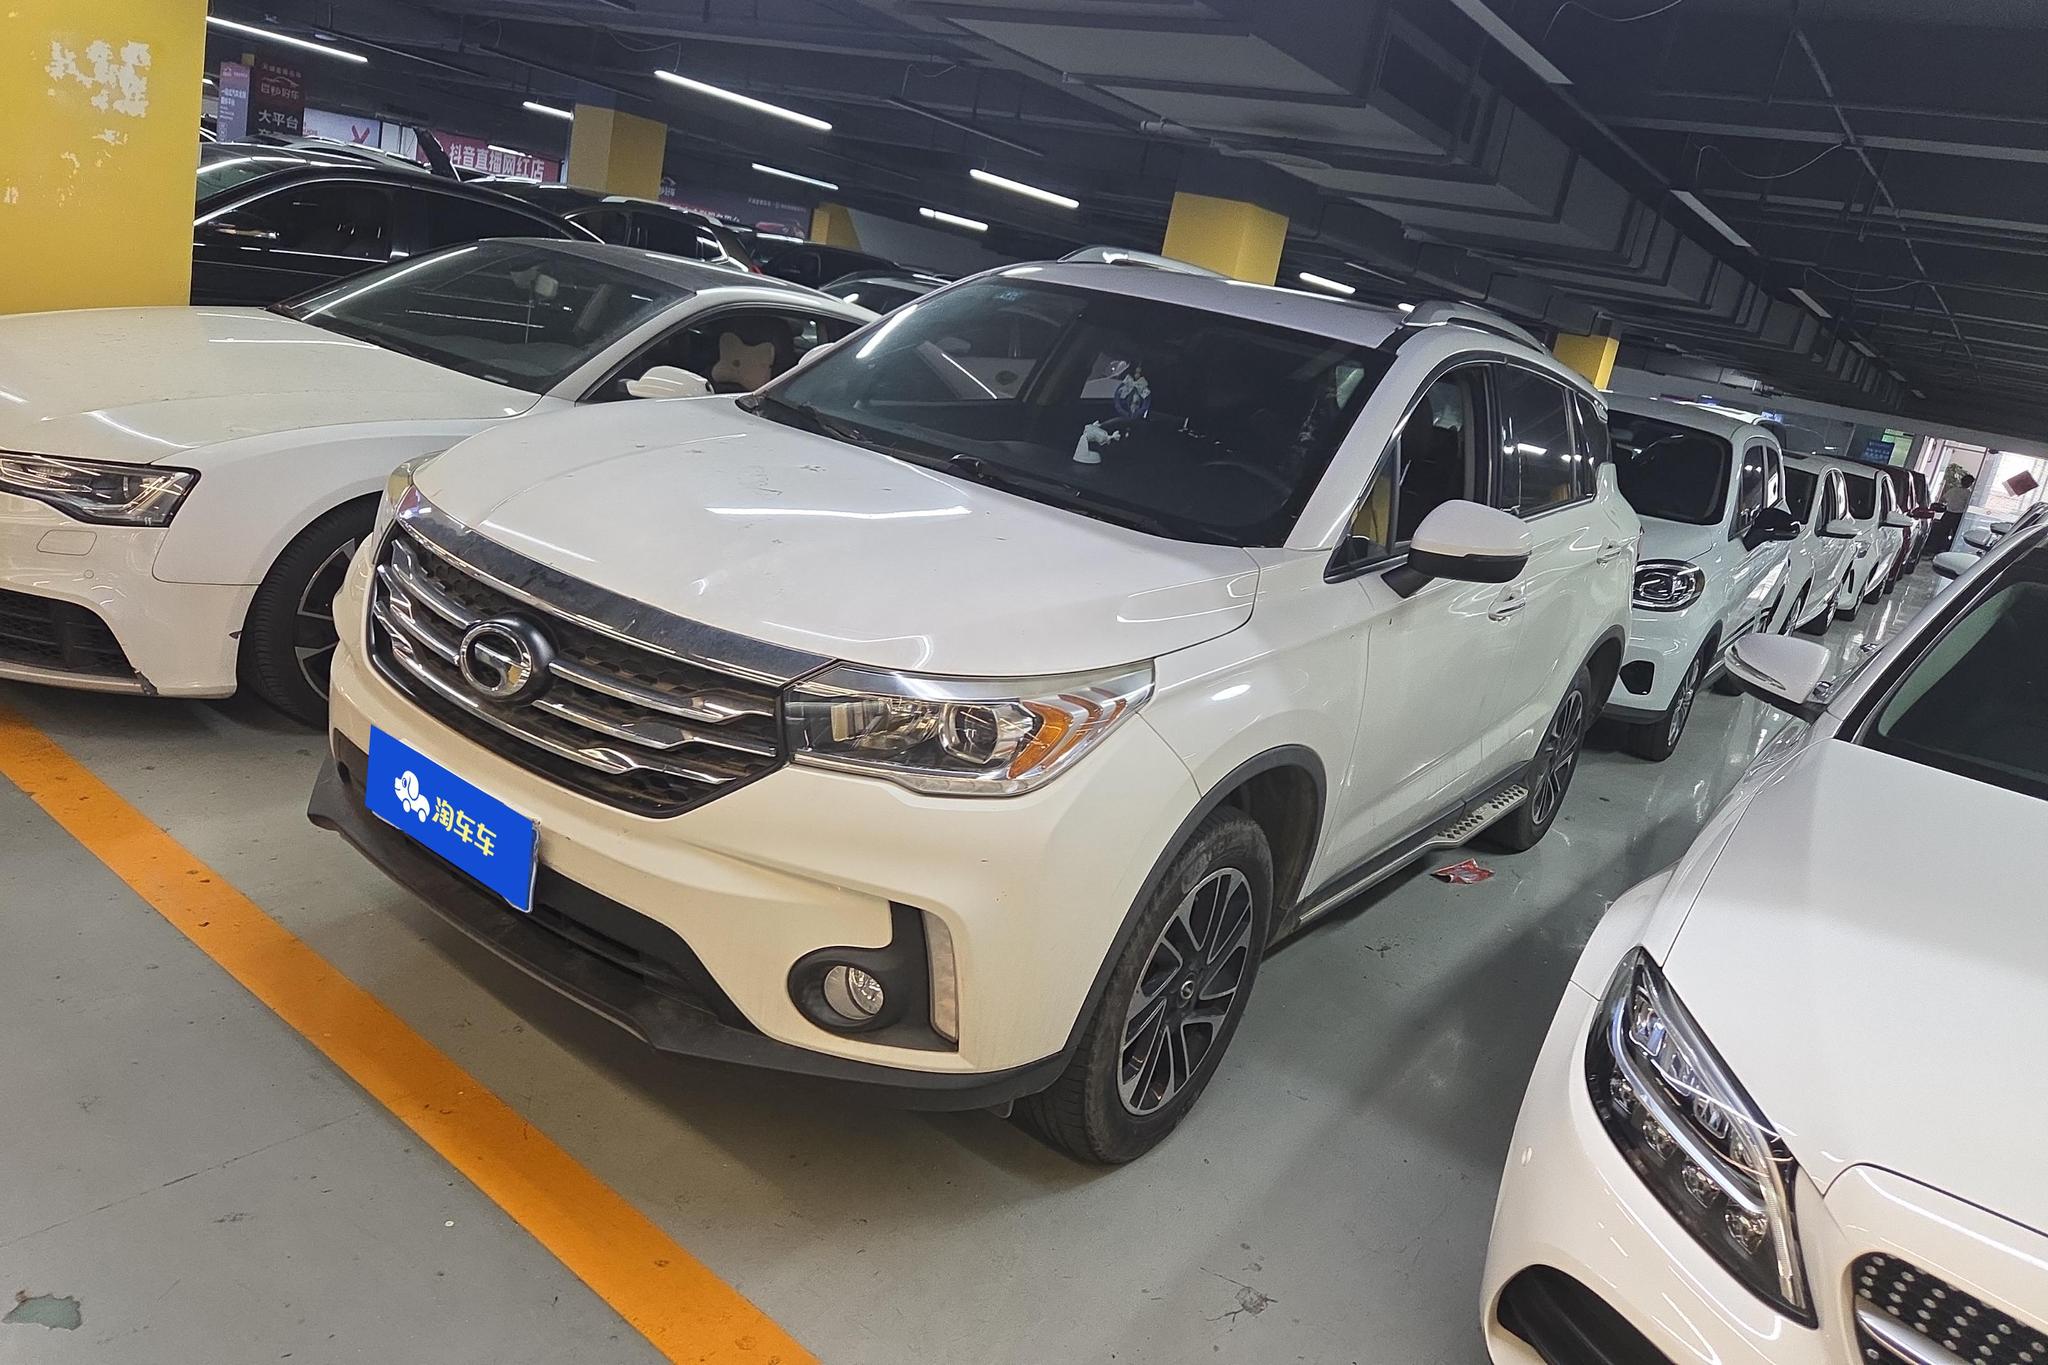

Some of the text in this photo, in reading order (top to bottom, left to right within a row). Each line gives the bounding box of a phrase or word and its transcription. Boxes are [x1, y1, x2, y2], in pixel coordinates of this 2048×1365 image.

[258, 109, 299, 130] 大平台
[449, 143, 545, 181] 抖音直播网红店
